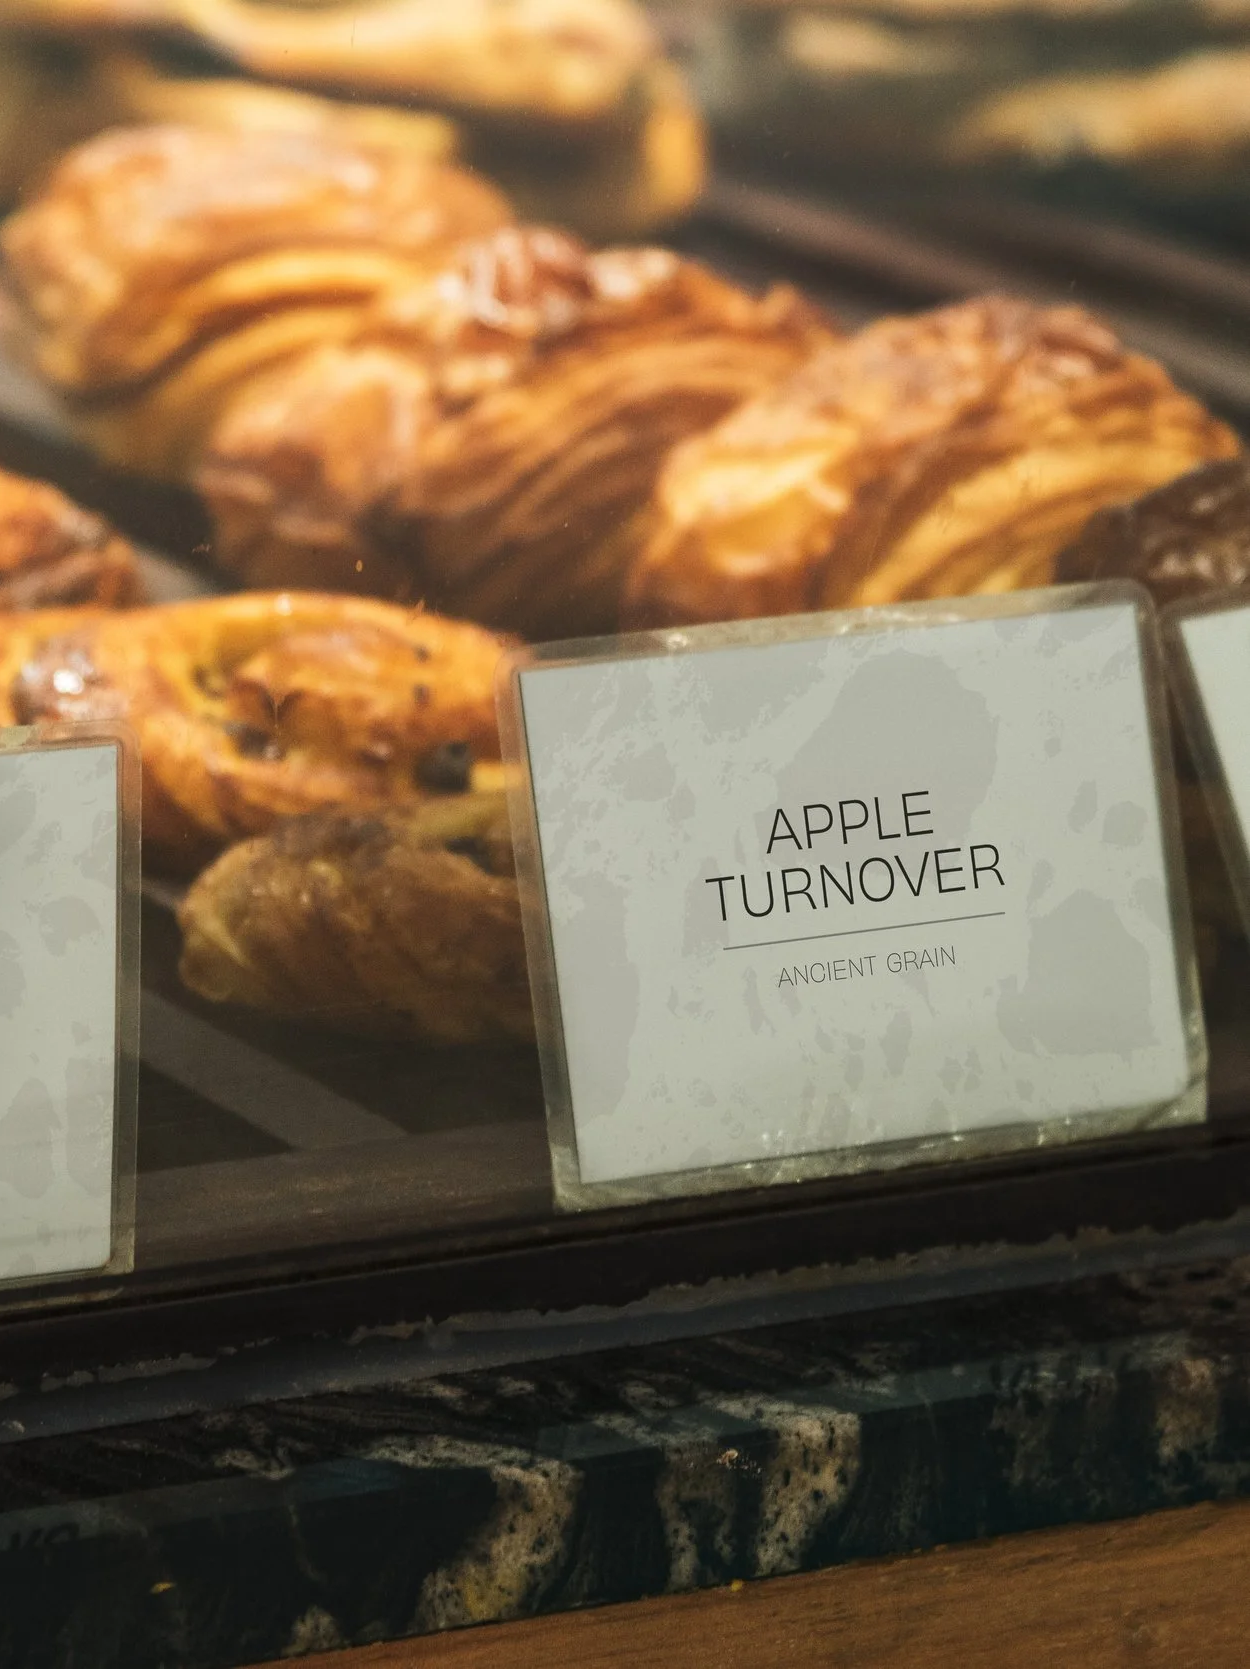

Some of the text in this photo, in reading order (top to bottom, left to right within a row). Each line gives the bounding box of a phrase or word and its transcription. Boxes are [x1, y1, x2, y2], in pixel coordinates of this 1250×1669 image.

[765, 790, 935, 855] APPLE
[704, 843, 1006, 922] TURNOVER
[777, 945, 956, 988] ANCIENT GRAIN
